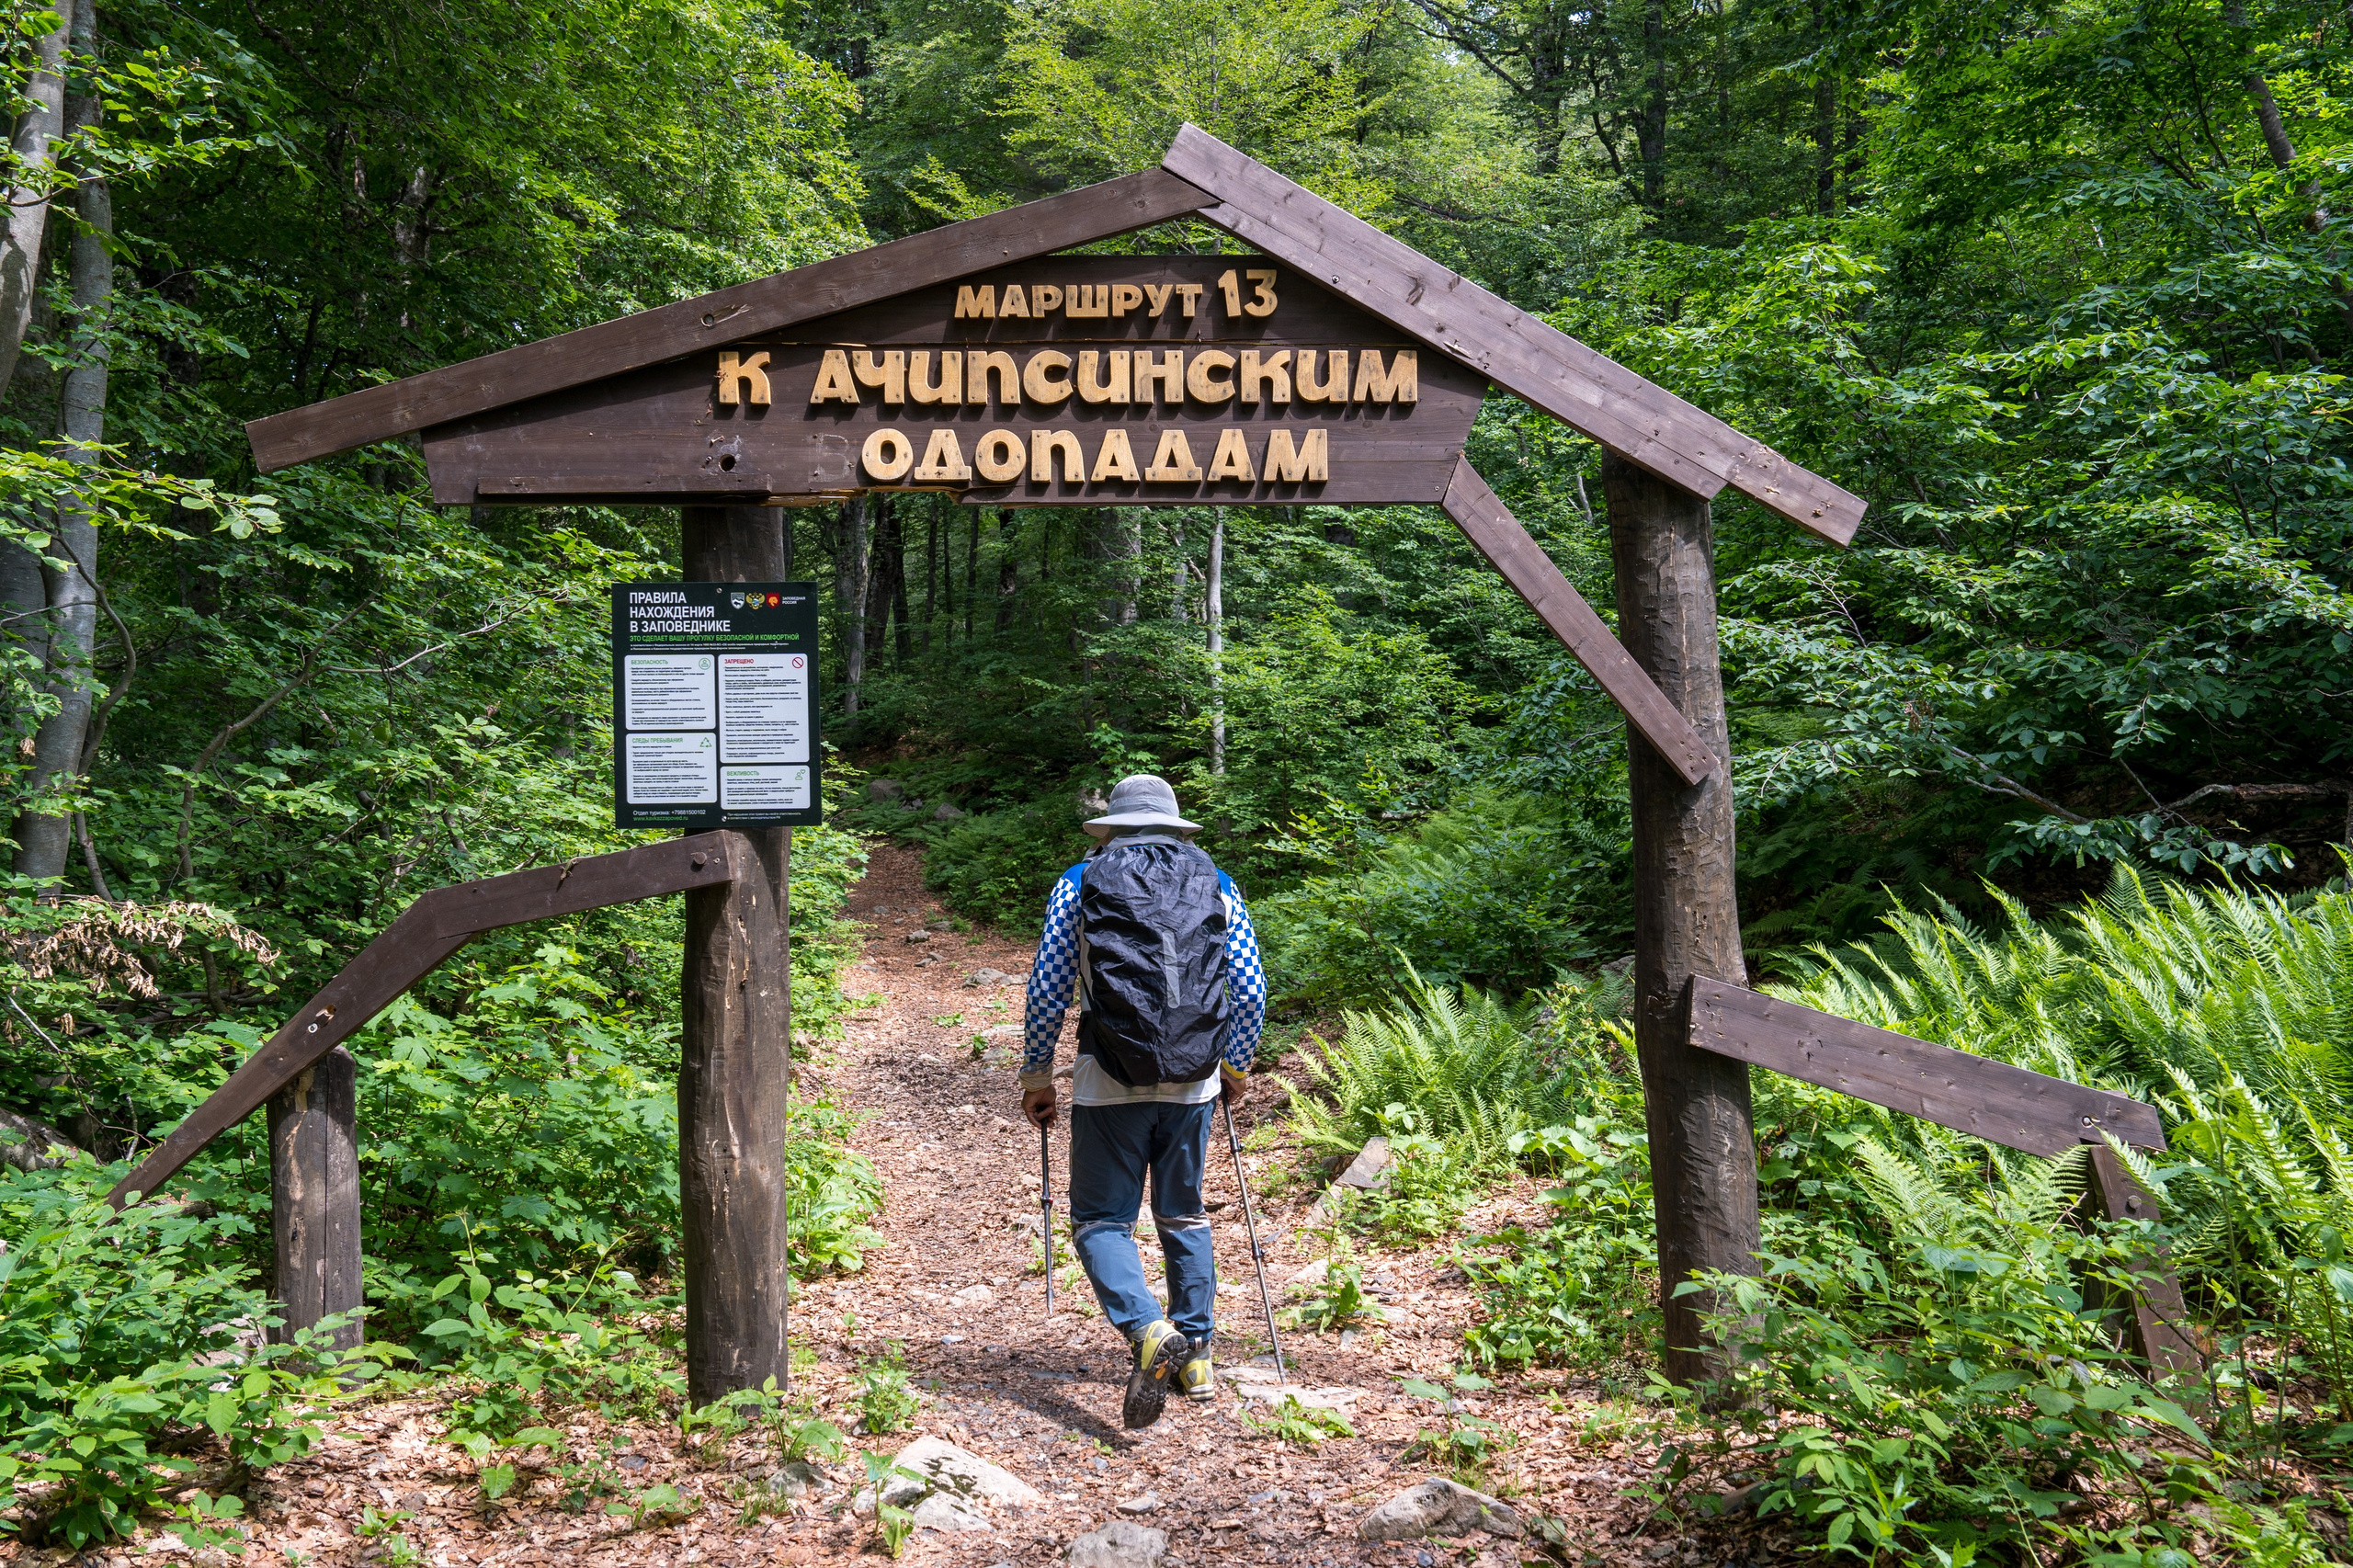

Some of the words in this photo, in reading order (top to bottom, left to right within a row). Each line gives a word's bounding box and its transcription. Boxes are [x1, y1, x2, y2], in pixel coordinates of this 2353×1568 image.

[954, 284, 1203, 319] МАРШРУТ
[1217, 269, 1279, 318] 13
[718, 351, 772, 406] К
[810, 349, 1419, 406] АЧИПСИНСКИМ
[630, 592, 687, 604] ПРАВИЛА
[630, 606, 715, 619] НАХОЖДЕНИЯ
[630, 620, 638, 632] В
[642, 620, 731, 634] ЗАПОВЕДНИКЕ
[760, 632, 800, 641] КОМФОРТНОЙ
